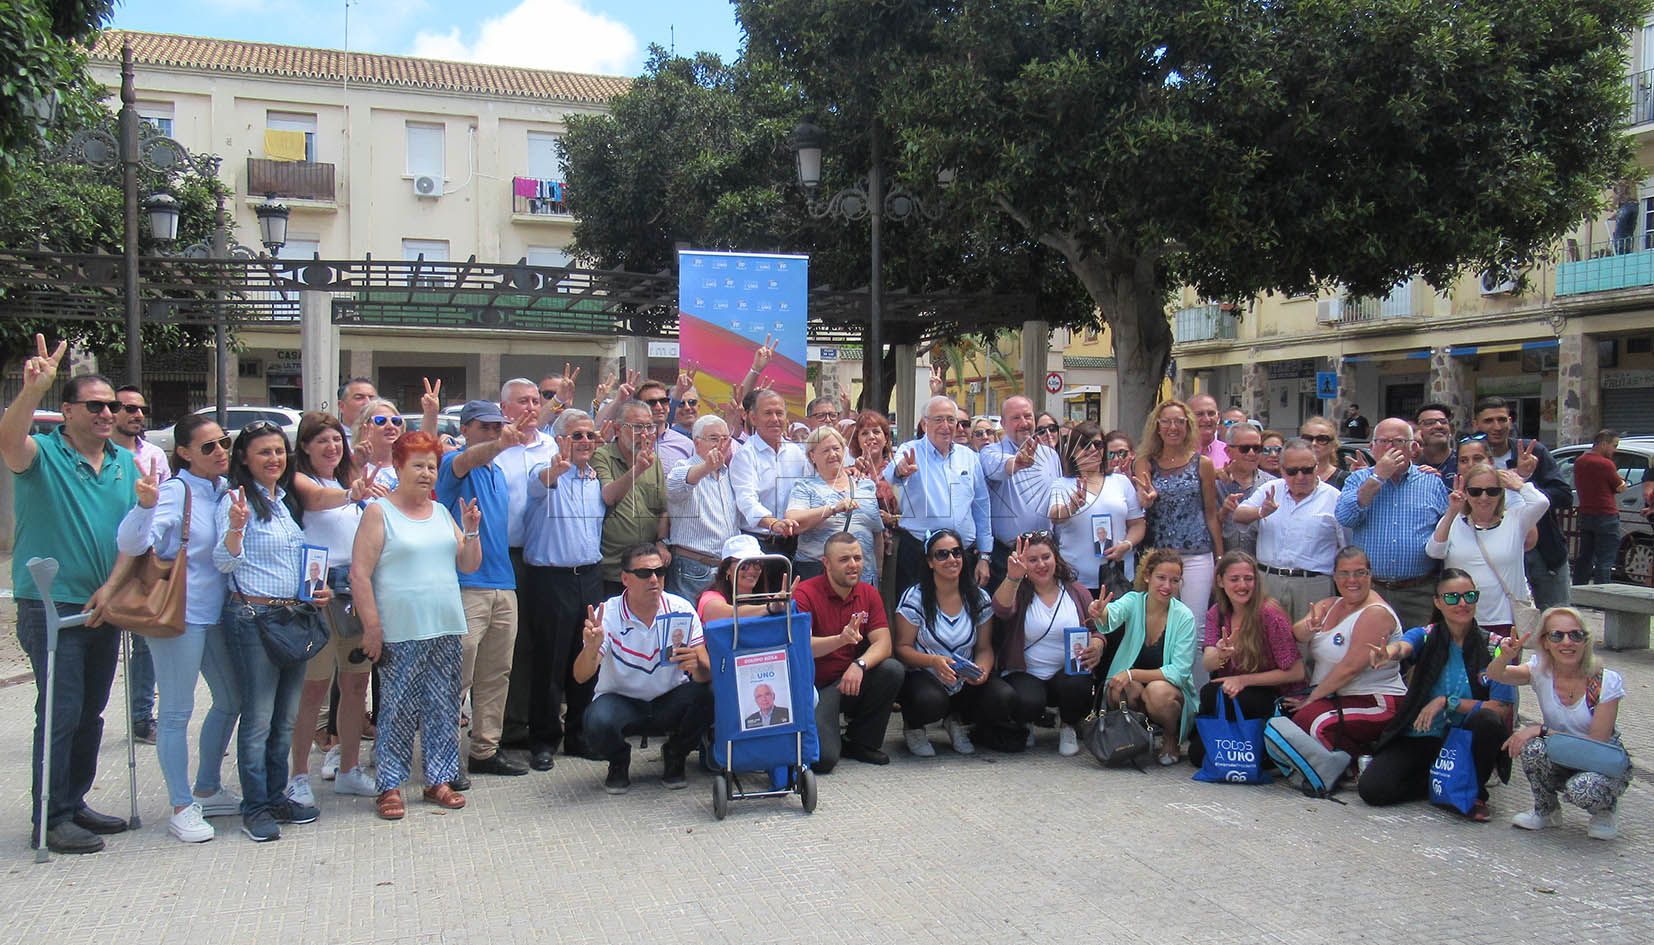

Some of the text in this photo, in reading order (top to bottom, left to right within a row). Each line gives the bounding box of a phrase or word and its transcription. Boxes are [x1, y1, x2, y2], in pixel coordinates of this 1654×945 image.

[757, 671, 775, 679] UNO
[1215, 739, 1253, 751] TODOS
[1214, 751, 1255, 762] A UNO
[1434, 758, 1455, 771] UNO
